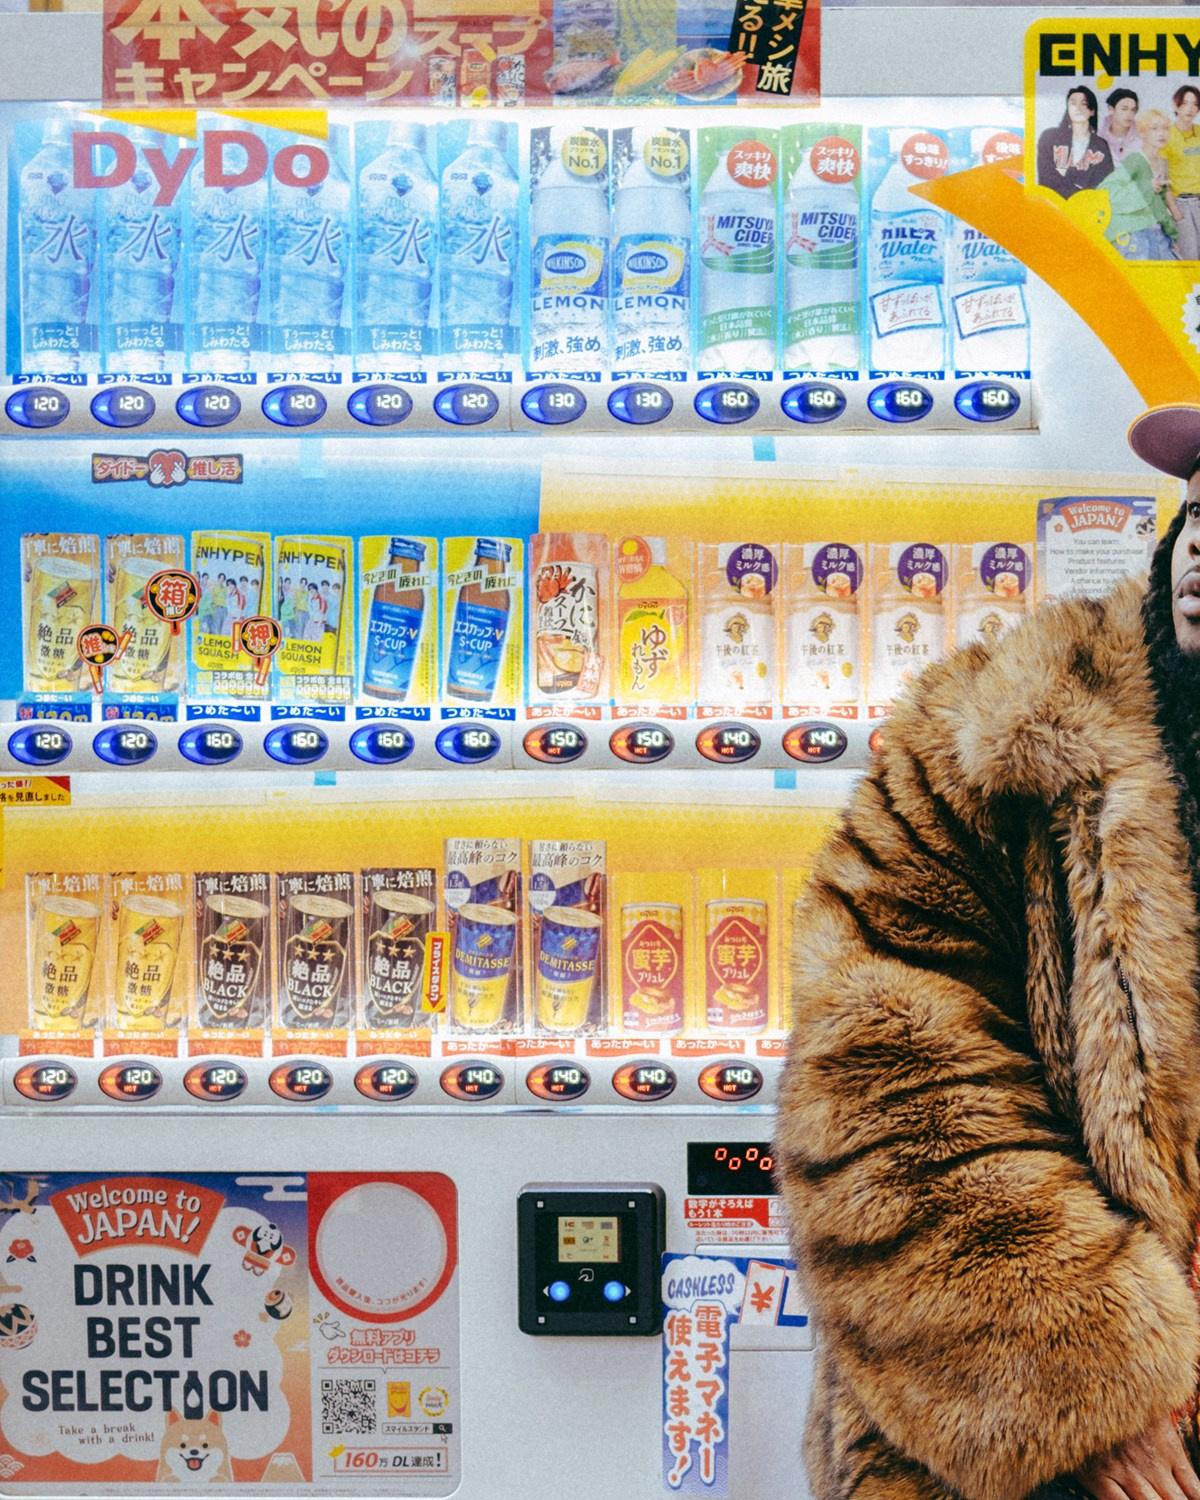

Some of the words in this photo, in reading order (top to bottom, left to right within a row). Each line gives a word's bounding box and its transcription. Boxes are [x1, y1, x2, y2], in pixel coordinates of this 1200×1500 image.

[414, 17, 548, 63] スープ
[115, 61, 414, 105] キャンペーン
[734, 149, 771, 161] スッキリ
[816, 146, 854, 158] スッキリ
[72, 130, 329, 207] DyDo
[568, 156, 600, 169] No.1
[817, 158, 855, 178] 爽快
[735, 161, 771, 182] 爽快
[32, 215, 87, 264] 水
[881, 228, 938, 241] カルピス
[880, 241, 937, 258] Water
[533, 295, 604, 312] LEMON
[615, 295, 686, 311] LEMON
[35, 397, 58, 411] 120
[377, 395, 402, 408] 120
[723, 392, 748, 406] 160
[98, 461, 148, 477] ダイドー
[193, 461, 236, 477] 推し活
[1068, 504, 1111, 516] Welcome
[1114, 507, 1125, 515] to
[1071, 513, 1123, 528] JAPAN!
[196, 545, 264, 568] ENHYPEN
[279, 551, 345, 571] ENHYPEN
[741, 546, 765, 560] 濃厚
[399, 573, 430, 589] 疲れに
[160, 580, 190, 607] 箱
[37, 622, 74, 646] 絶品
[285, 643, 322, 655] LEMON
[374, 637, 407, 650] S-CUP
[641, 624, 667, 679] ゆず
[198, 647, 239, 660] SQUASH
[281, 652, 321, 664] SQUASH
[631, 644, 645, 691] れもん
[206, 732, 232, 747] 160
[638, 731, 663, 746] 150
[454, 841, 508, 850] 甘さに頼らない
[448, 852, 518, 865] 最高峰のコク
[532, 853, 603, 868] 最高峰のコク
[456, 949, 510, 969] DEMITASSE
[539, 950, 595, 972] DEMITASSE
[632, 947, 672, 971] 蜜芋
[207, 960, 246, 984] 絶品
[203, 978, 248, 997] BLACK
[287, 978, 332, 998] BLACK
[41, 1069, 67, 1084] 120
[383, 1069, 409, 1084] 120
[467, 1069, 493, 1084] 140
[66, 1185, 168, 1215] Welcome
[175, 1190, 201, 1213] to
[688, 1200, 754, 1209] 数字がそろえば
[688, 1209, 723, 1218] もう1本
[77, 1208, 201, 1246] JAPAN!
[73, 1263, 214, 1307] DRINK
[667, 1272, 736, 1300] CASHLESS
[87, 1316, 200, 1359] BEST
[350, 1328, 416, 1347] 無料アプリ
[327, 1346, 441, 1364] ダウンロードはコチラ
[694, 1304, 725, 1480] 電子マネー
[59, 1425, 84, 1435] Take
[103, 1422, 136, 1434] break
[385, 1425, 430, 1433] スマイルスタンド
[79, 1435, 102, 1445] with
[122, 1433, 155, 1443] drink!
